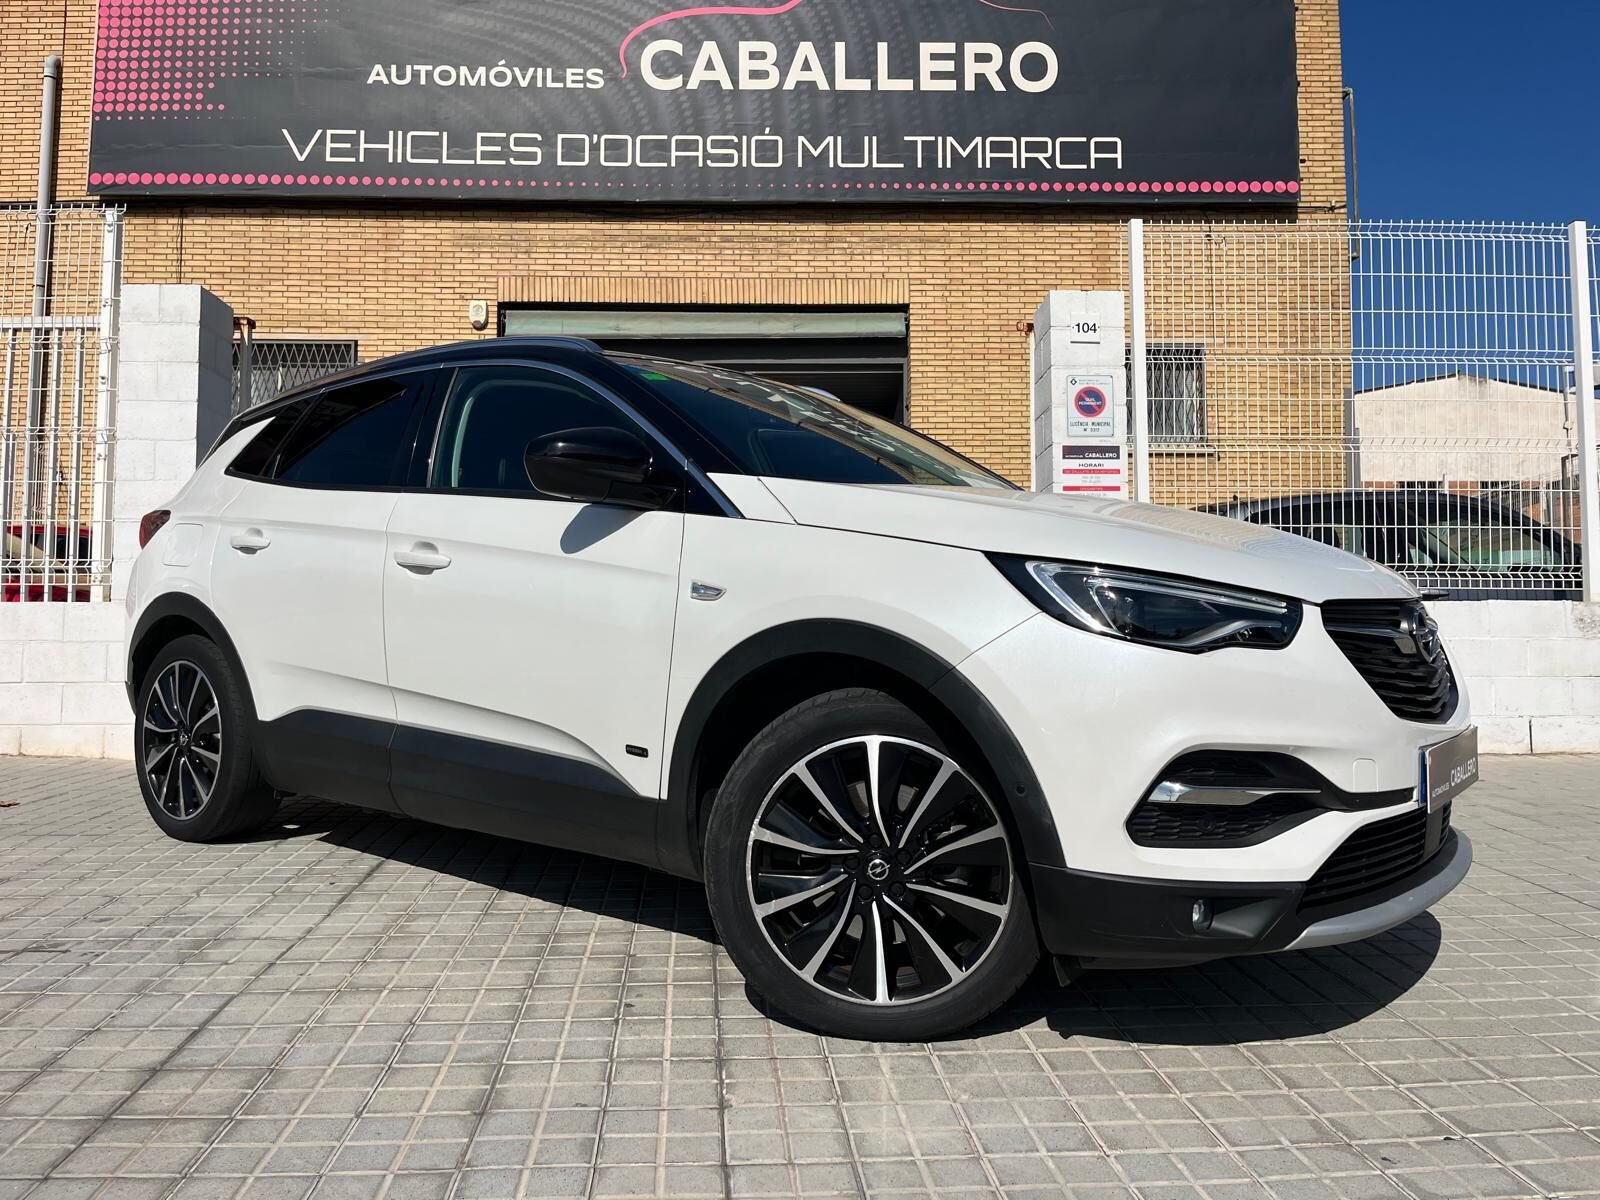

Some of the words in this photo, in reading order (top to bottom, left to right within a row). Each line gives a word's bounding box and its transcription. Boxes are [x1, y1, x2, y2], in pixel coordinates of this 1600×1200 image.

[367, 59, 605, 90] AUTOMÓVILES
[640, 39, 1059, 93] CABALLERO
[281, 128, 543, 167] VEHICLES
[556, 127, 784, 169] D'OCASIÓ
[797, 135, 1124, 170] MULTIMARCA
[1074, 322, 1098, 334] 104
[1450, 756, 1477, 787] CABALLERO
